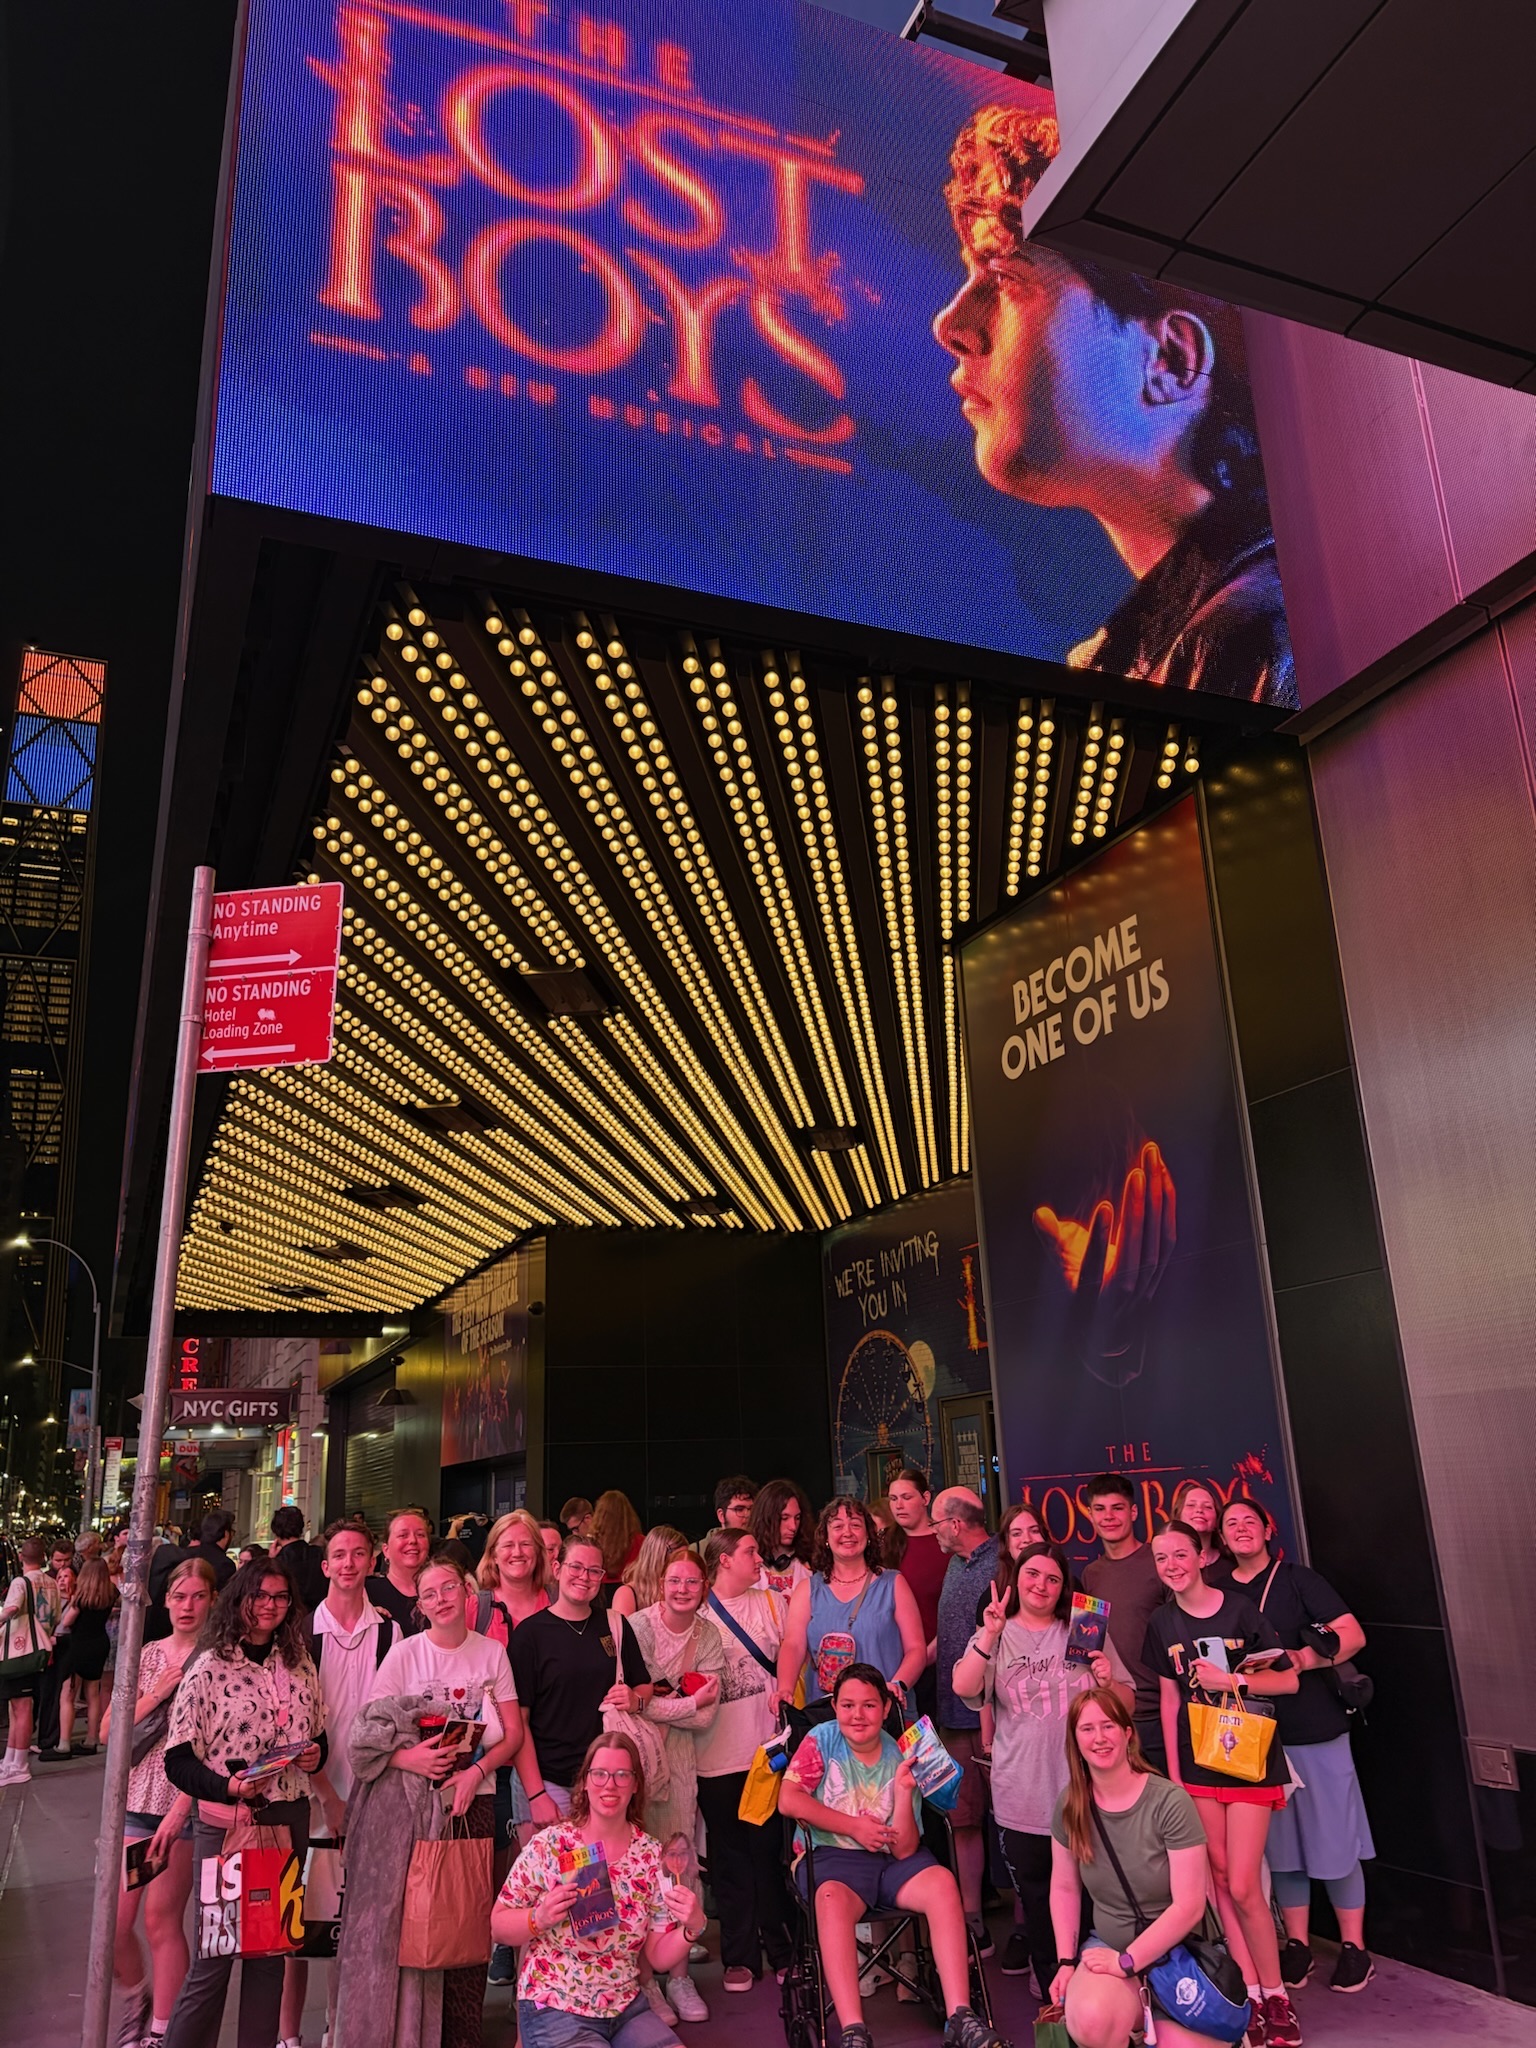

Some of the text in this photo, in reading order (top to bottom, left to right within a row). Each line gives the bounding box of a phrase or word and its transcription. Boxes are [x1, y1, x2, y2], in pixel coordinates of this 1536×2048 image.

[509, 0, 693, 92] THE
[305, 5, 866, 292] LOST
[318, 158, 857, 443] BOYS
[213, 894, 322, 919] NO STANDING
[212, 920, 279, 942] Anytime
[1012, 913, 1142, 1026] BECOME
[205, 979, 311, 1004] NO STANDING
[202, 1021, 283, 1040] Loading Zone
[204, 1006, 236, 1023] Hotel
[1001, 958, 1170, 1080] ONE OF US
[834, 1230, 940, 1299] WE'RE INVITING
[857, 1279, 908, 1327] YOU IN
[183, 1400, 279, 1417] NYC GIFTS
[1105, 1442, 1153, 1464] THE
